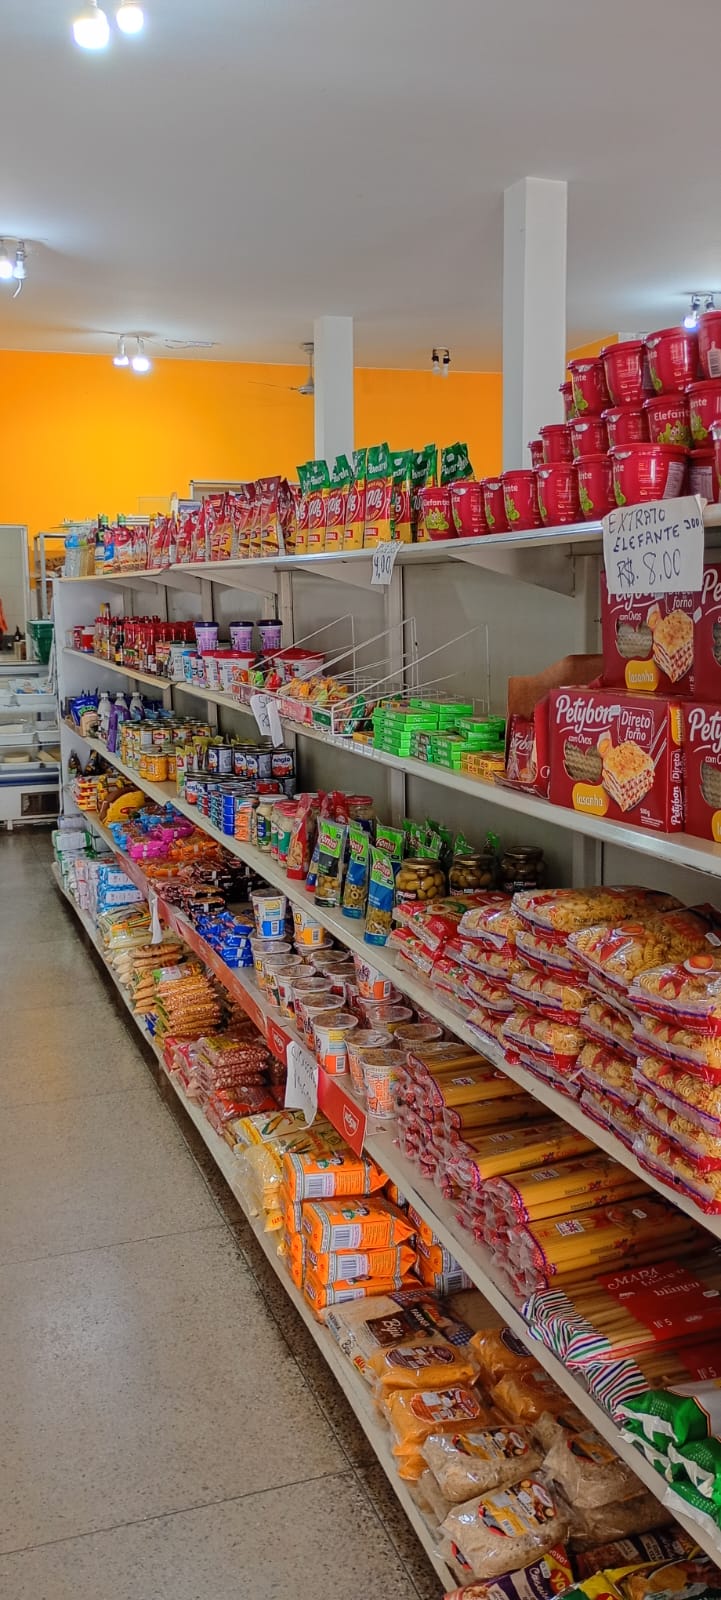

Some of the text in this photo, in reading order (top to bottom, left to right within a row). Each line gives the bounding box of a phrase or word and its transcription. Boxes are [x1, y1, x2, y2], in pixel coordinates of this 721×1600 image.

[653, 409, 691, 422] Elefant
[608, 507, 666, 535] EXTRATO
[613, 524, 680, 553] ELEFANTE
[671, 596, 693, 612] forno
[628, 611, 642, 621] Ovos
[556, 694, 614, 734] Petybon
[621, 711, 651, 729] Direto
[577, 733, 593, 745] Ovos
[624, 727, 646, 741] forno
[670, 786, 683, 826] Petybon
